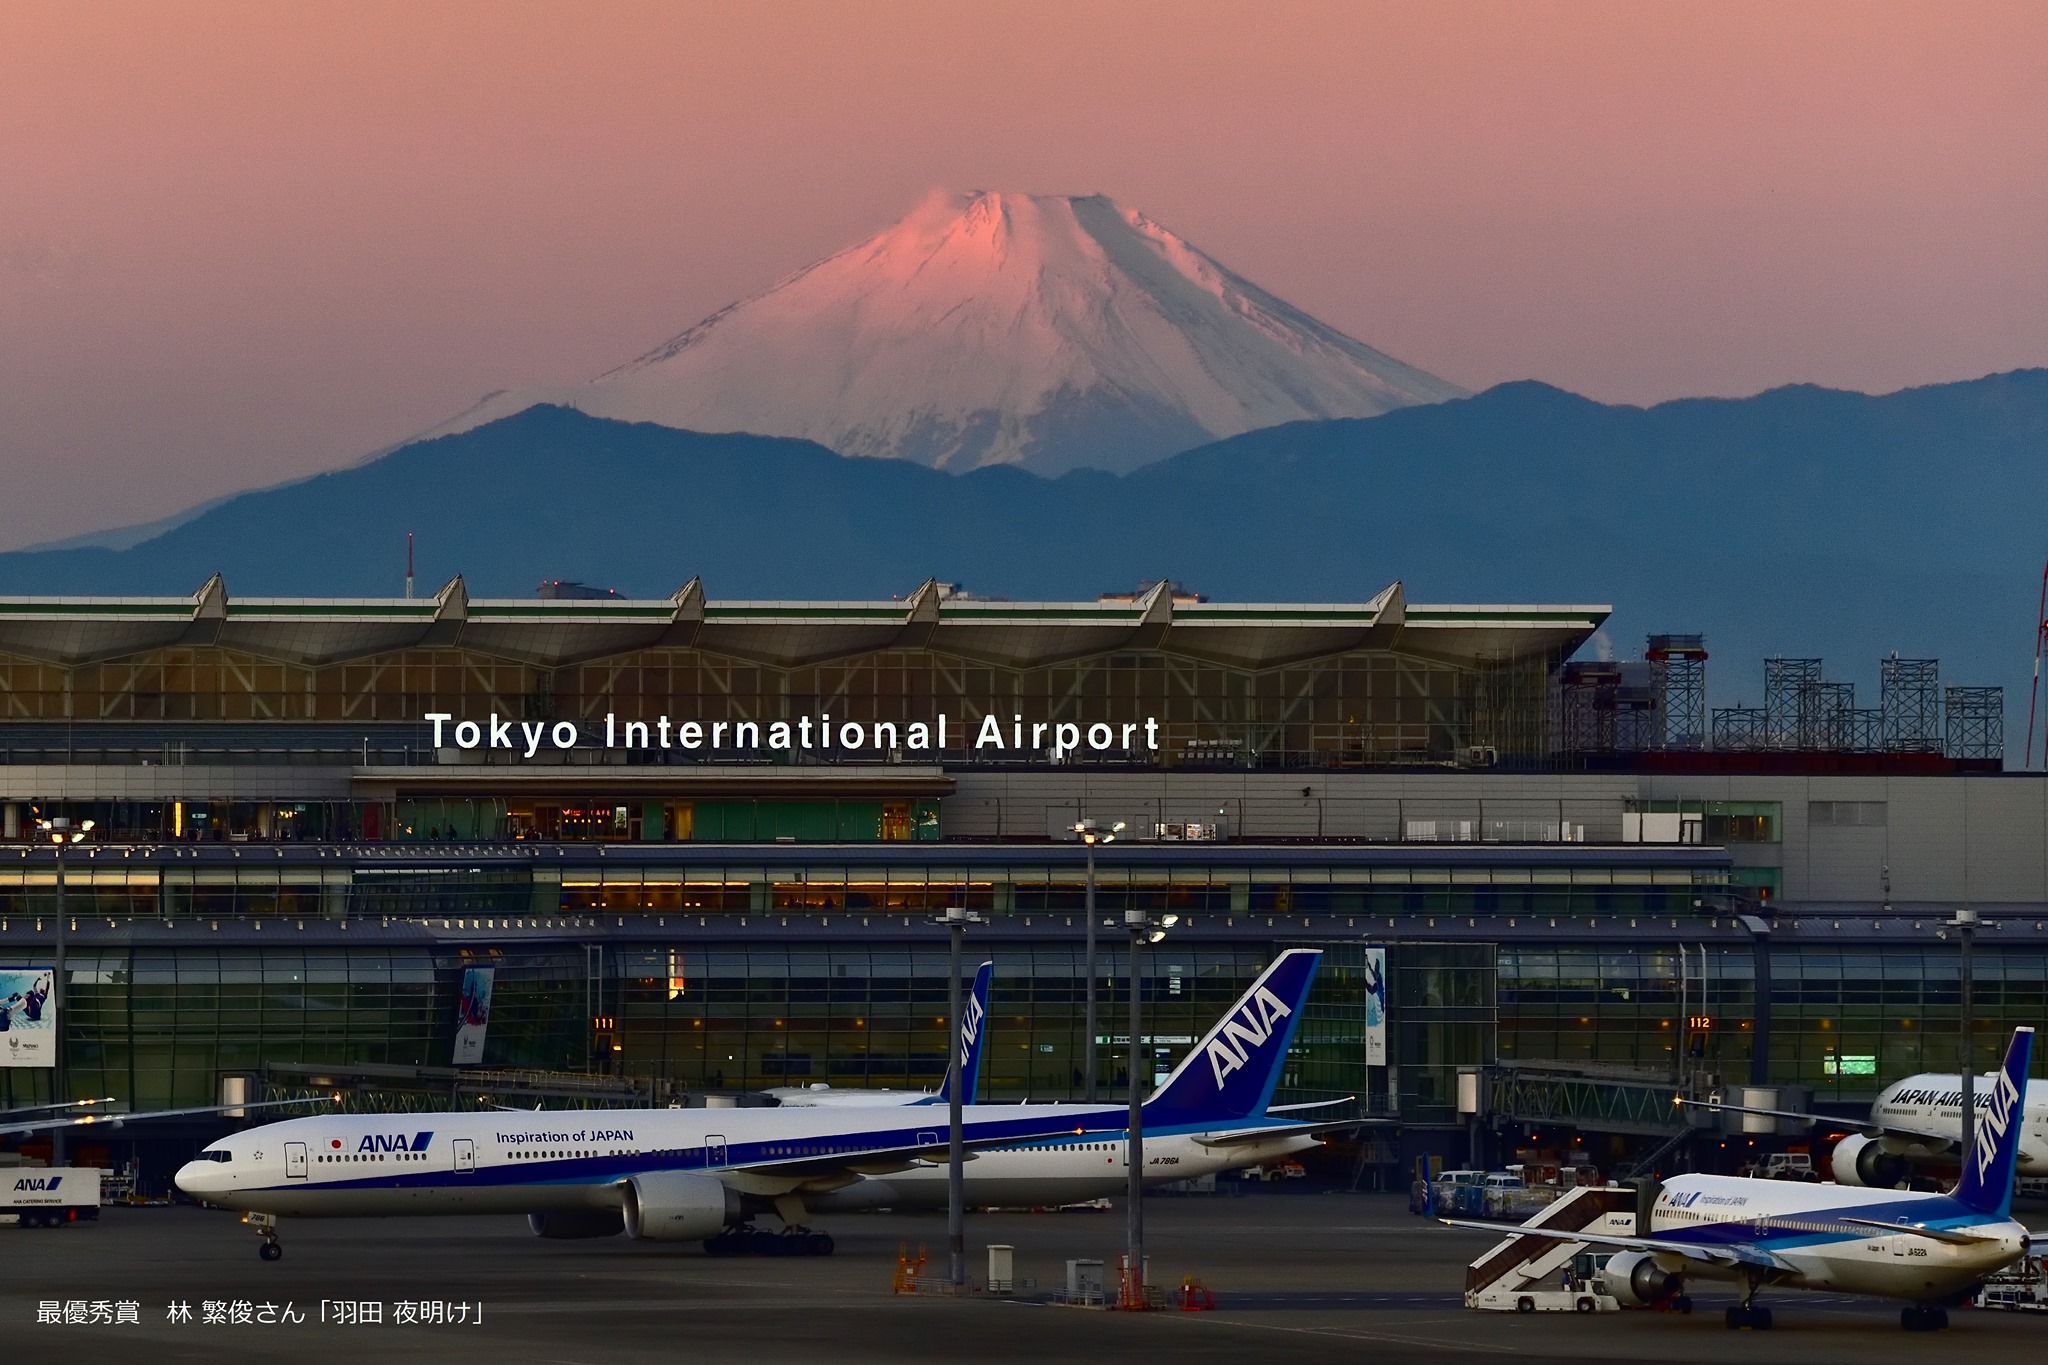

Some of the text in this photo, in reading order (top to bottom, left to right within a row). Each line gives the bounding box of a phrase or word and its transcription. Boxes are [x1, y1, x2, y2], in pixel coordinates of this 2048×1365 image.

[425, 713, 1159, 759] Tokyo International Airport
[595, 1018, 613, 1029] 111
[1690, 1017, 1710, 1028] 112
[1206, 986, 1292, 1091] ANA
[1890, 1088, 1940, 1105] JAPAN
[1976, 1065, 2020, 1188] ANA
[357, 1134, 409, 1153] ANA
[496, 1129, 635, 1146] Inspiration of JAPAN
[1149, 1157, 1180, 1165] JA786A
[13, 1178, 46, 1192] ANA
[1667, 1191, 1691, 1208] ANA
